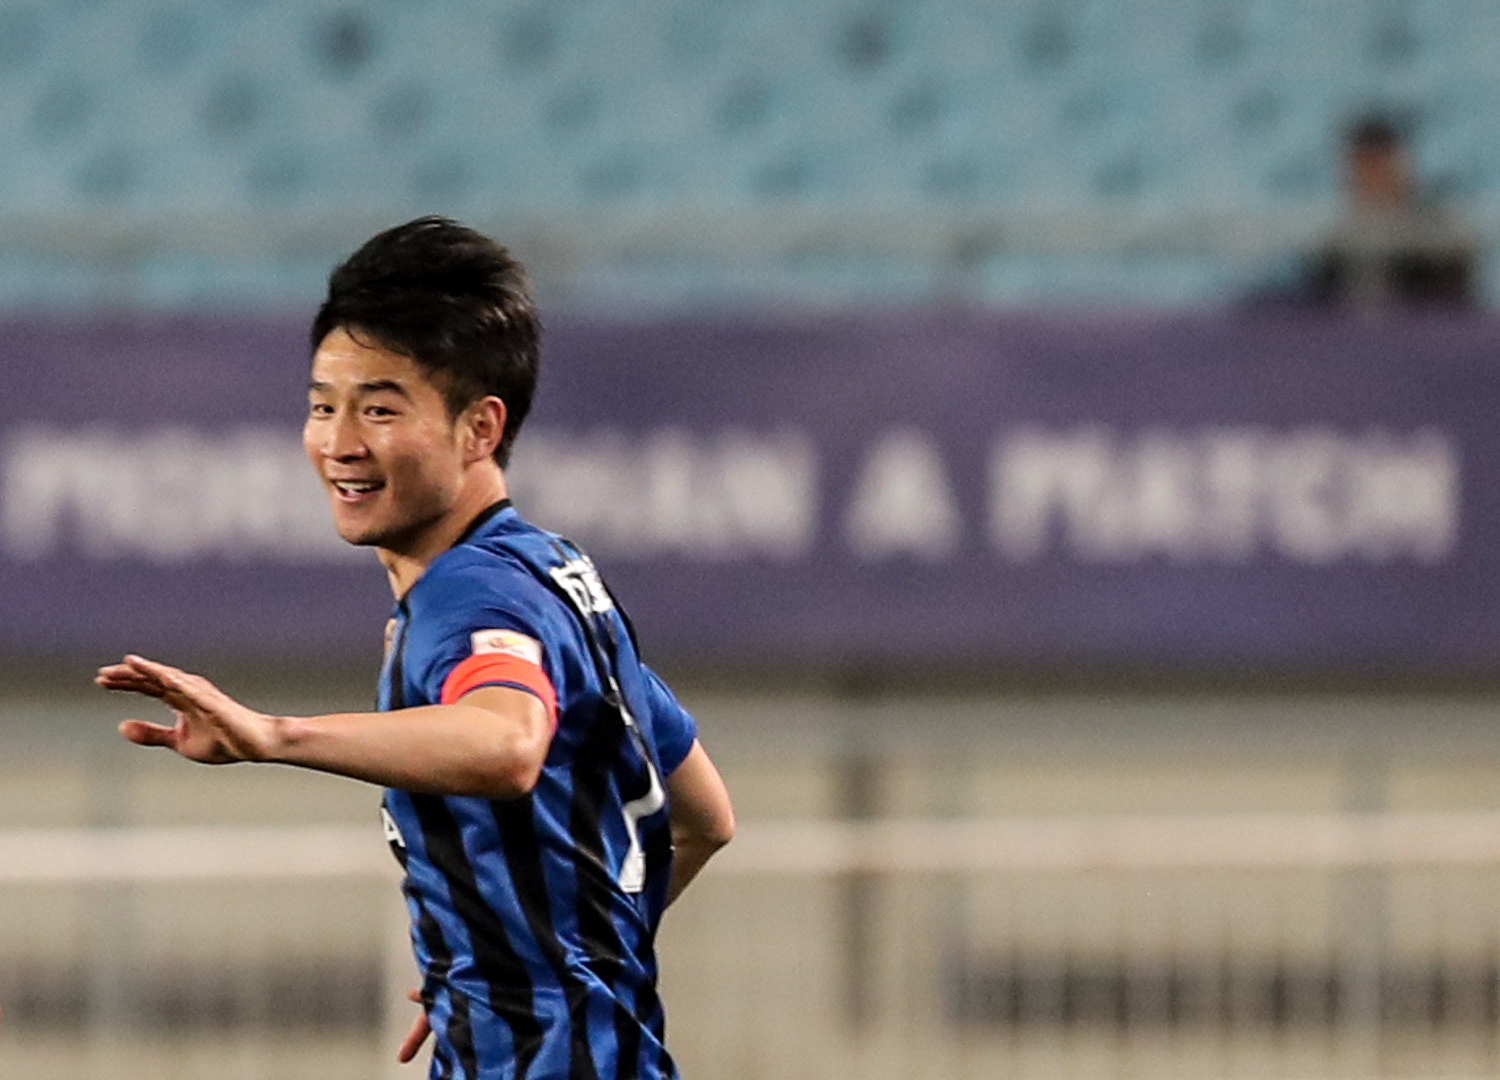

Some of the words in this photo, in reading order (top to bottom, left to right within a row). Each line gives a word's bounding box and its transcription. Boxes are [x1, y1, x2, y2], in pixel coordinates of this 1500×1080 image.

[508, 426, 818, 562] HAN
[846, 424, 964, 562] A
[992, 424, 1458, 562] MATCH
